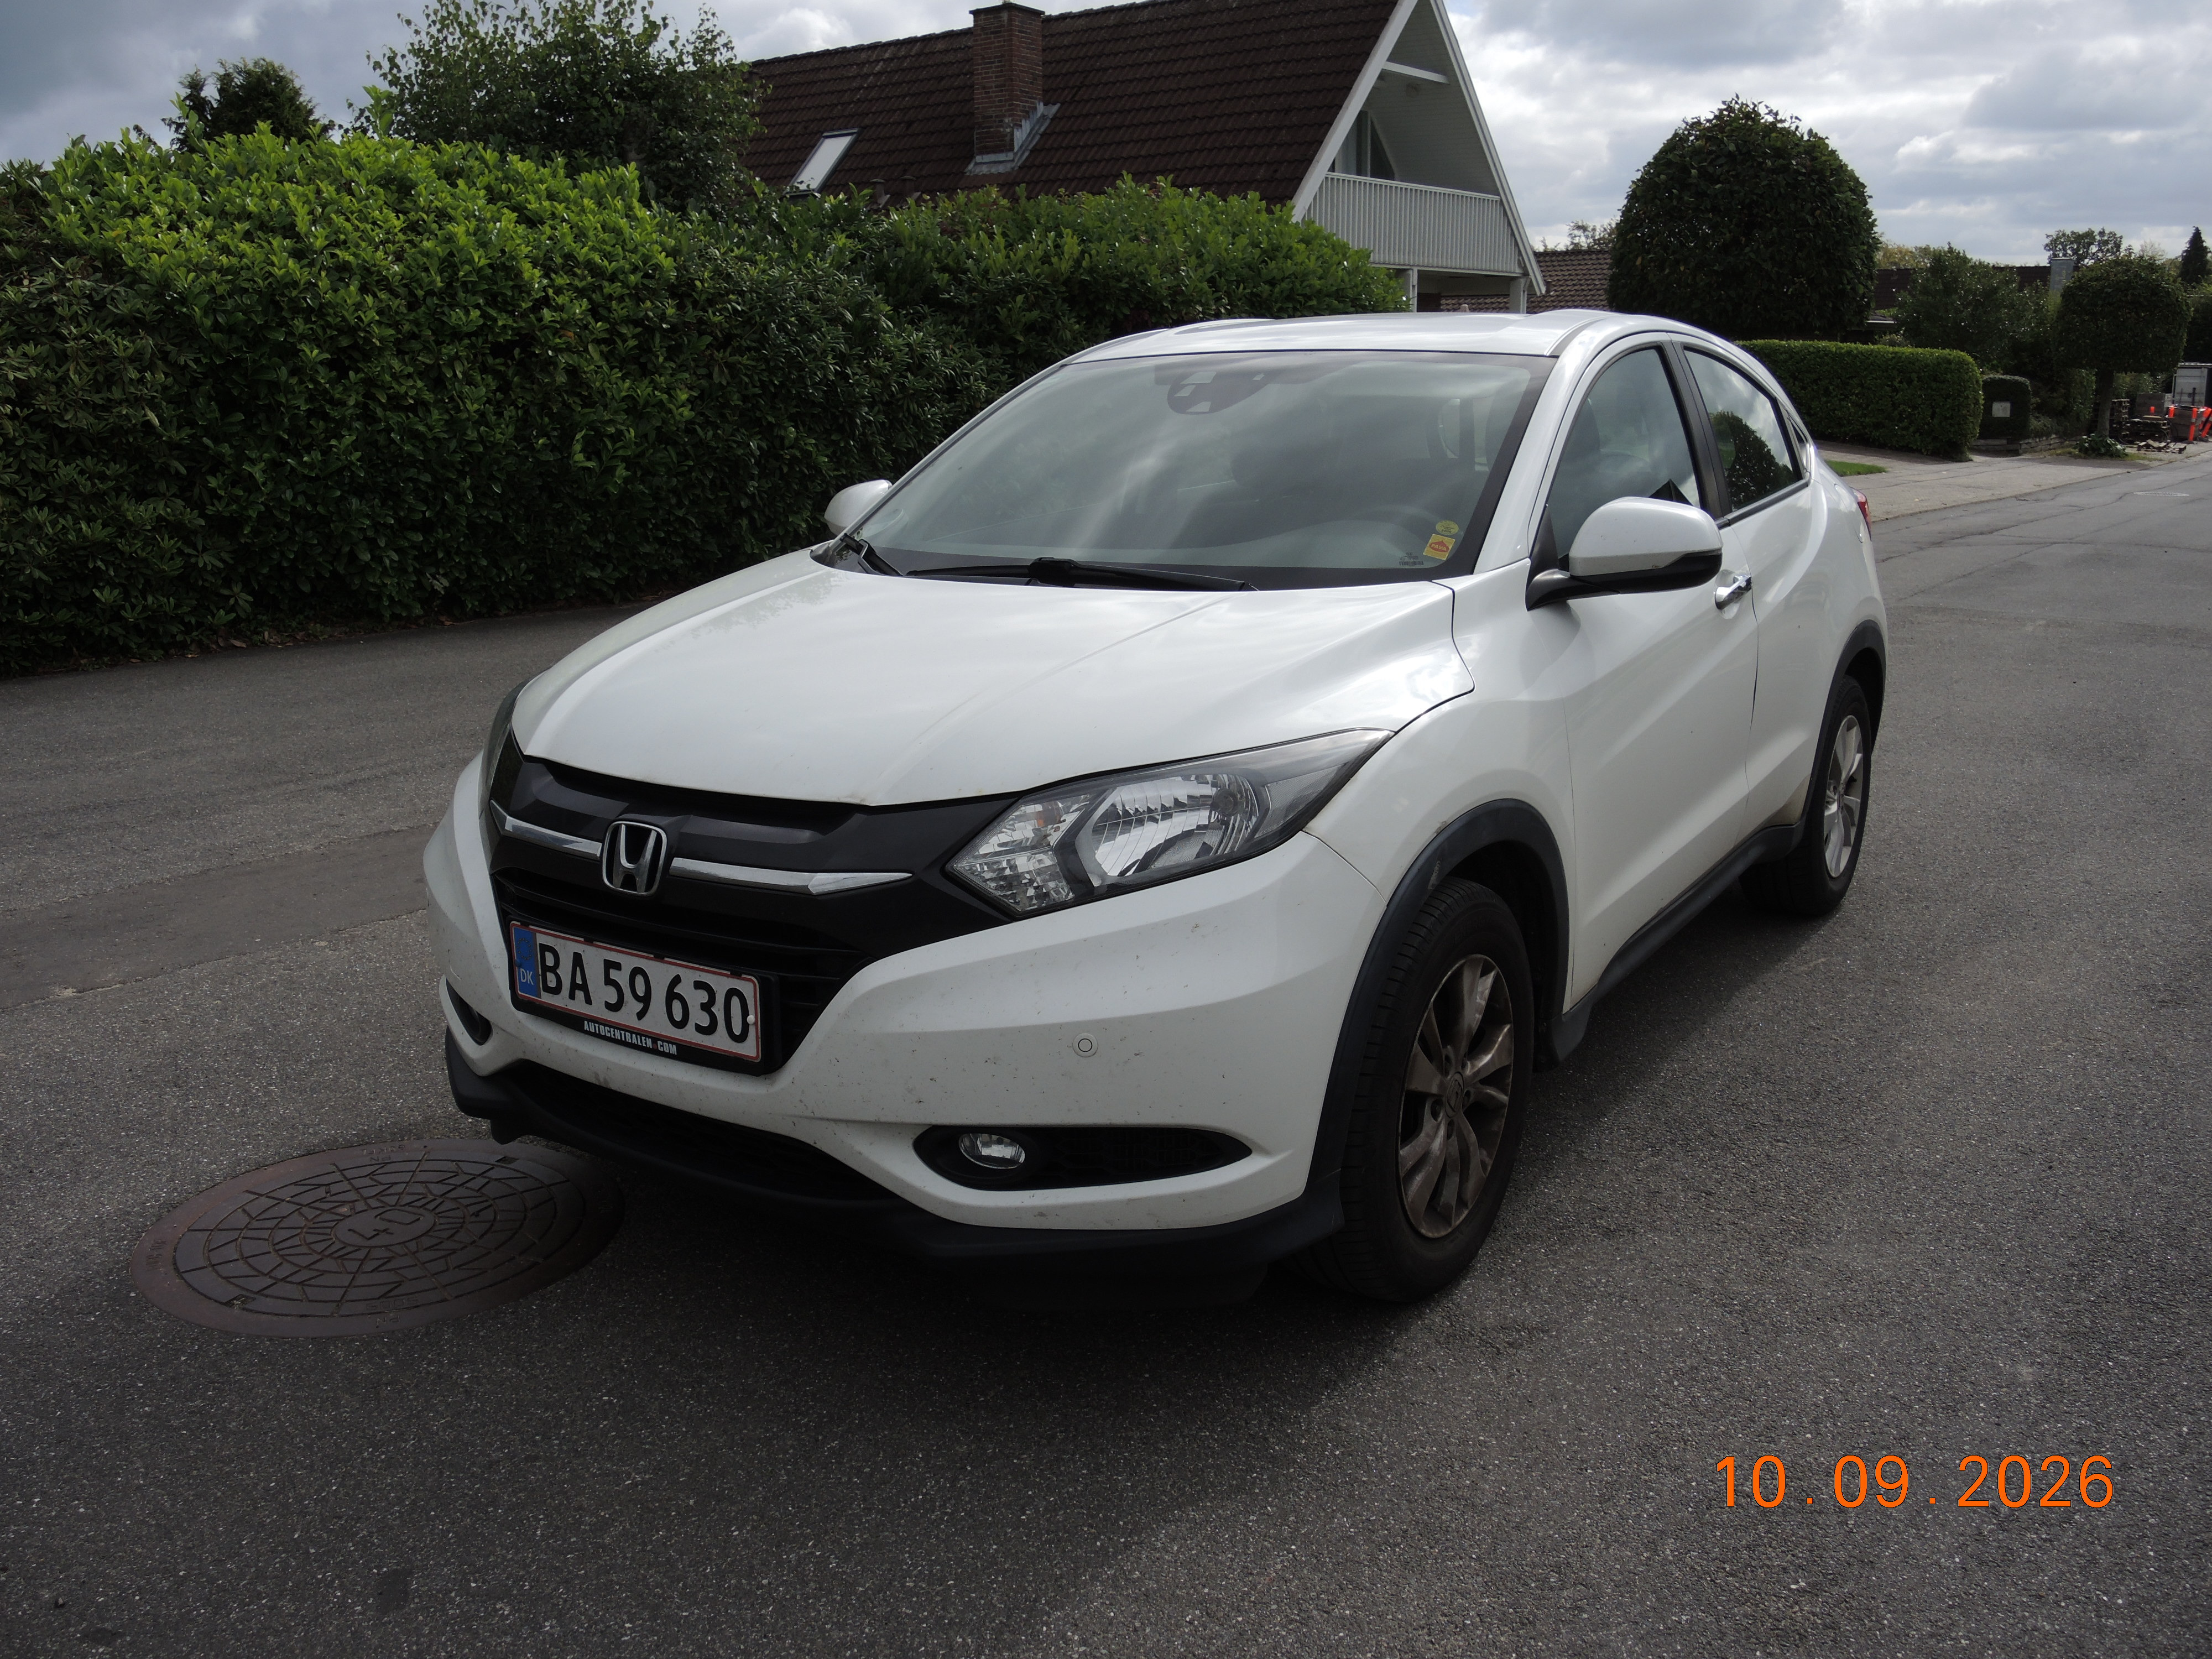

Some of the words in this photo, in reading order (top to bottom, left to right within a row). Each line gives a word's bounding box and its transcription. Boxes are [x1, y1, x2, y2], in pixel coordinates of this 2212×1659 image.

[520, 968, 534, 986] DK
[539, 943, 593, 1005] BA
[603, 959, 652, 1021] 59
[665, 974, 749, 1043] 630
[584, 1021, 677, 1055] AUTOCENTRALEN.COM
